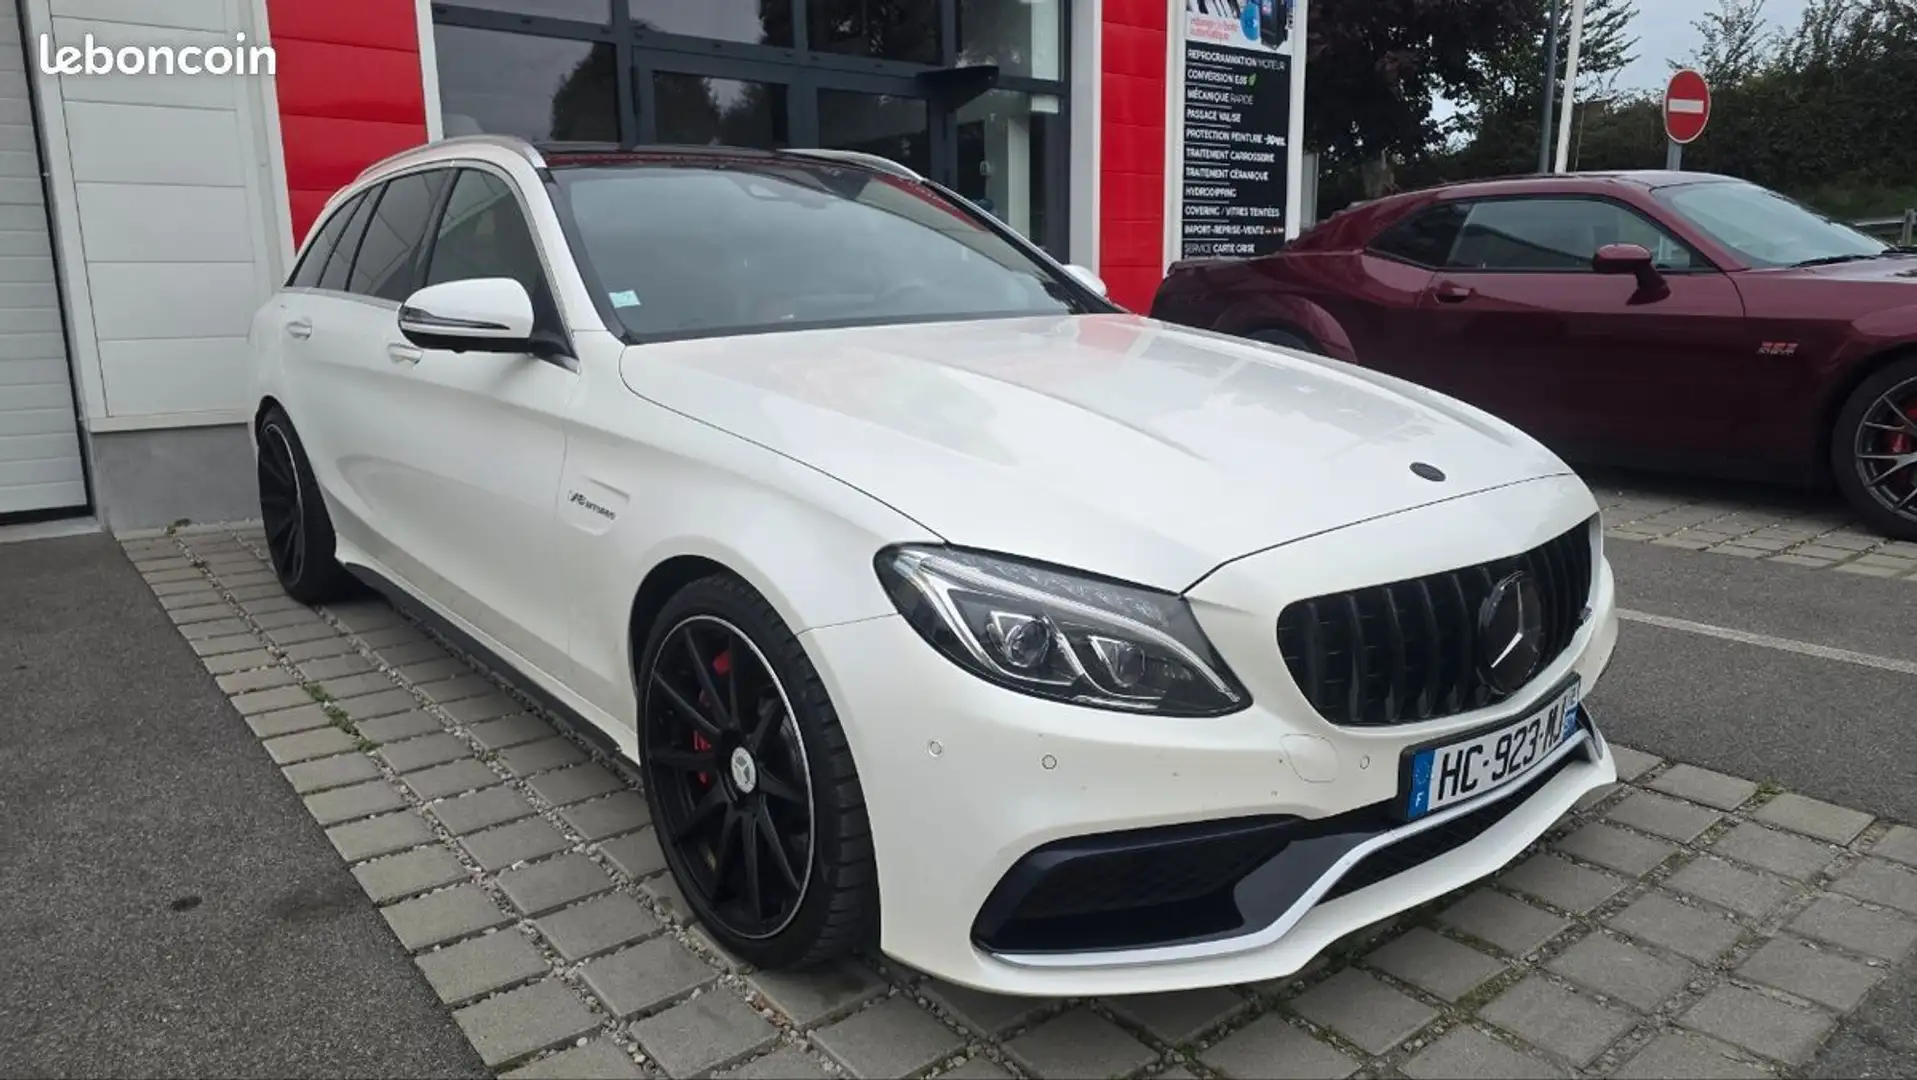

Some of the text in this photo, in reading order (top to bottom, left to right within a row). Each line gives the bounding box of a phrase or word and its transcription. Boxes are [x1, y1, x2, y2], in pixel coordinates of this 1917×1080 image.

[1187, 69, 1233, 83] CONVERSION
[1187, 87, 1230, 103] MÉCANIQUE
[1187, 108, 1241, 123] PASSAGE VALISE
[1186, 128, 1230, 141] PROTECTION
[1231, 131, 1263, 143] PEINTURE
[1186, 148, 1275, 163] TRAITEMENT CARROSSERIE
[1186, 167, 1269, 181] TRAITEMENT CÉRAMIQUE
[1184, 205, 1220, 216] COVERING
[1226, 207, 1249, 217] VITRES
[1249, 205, 1280, 217] TEINTÉES
[1184, 243, 1256, 254] SERVICE CARTE GRISE
[1415, 791, 1425, 808] F
